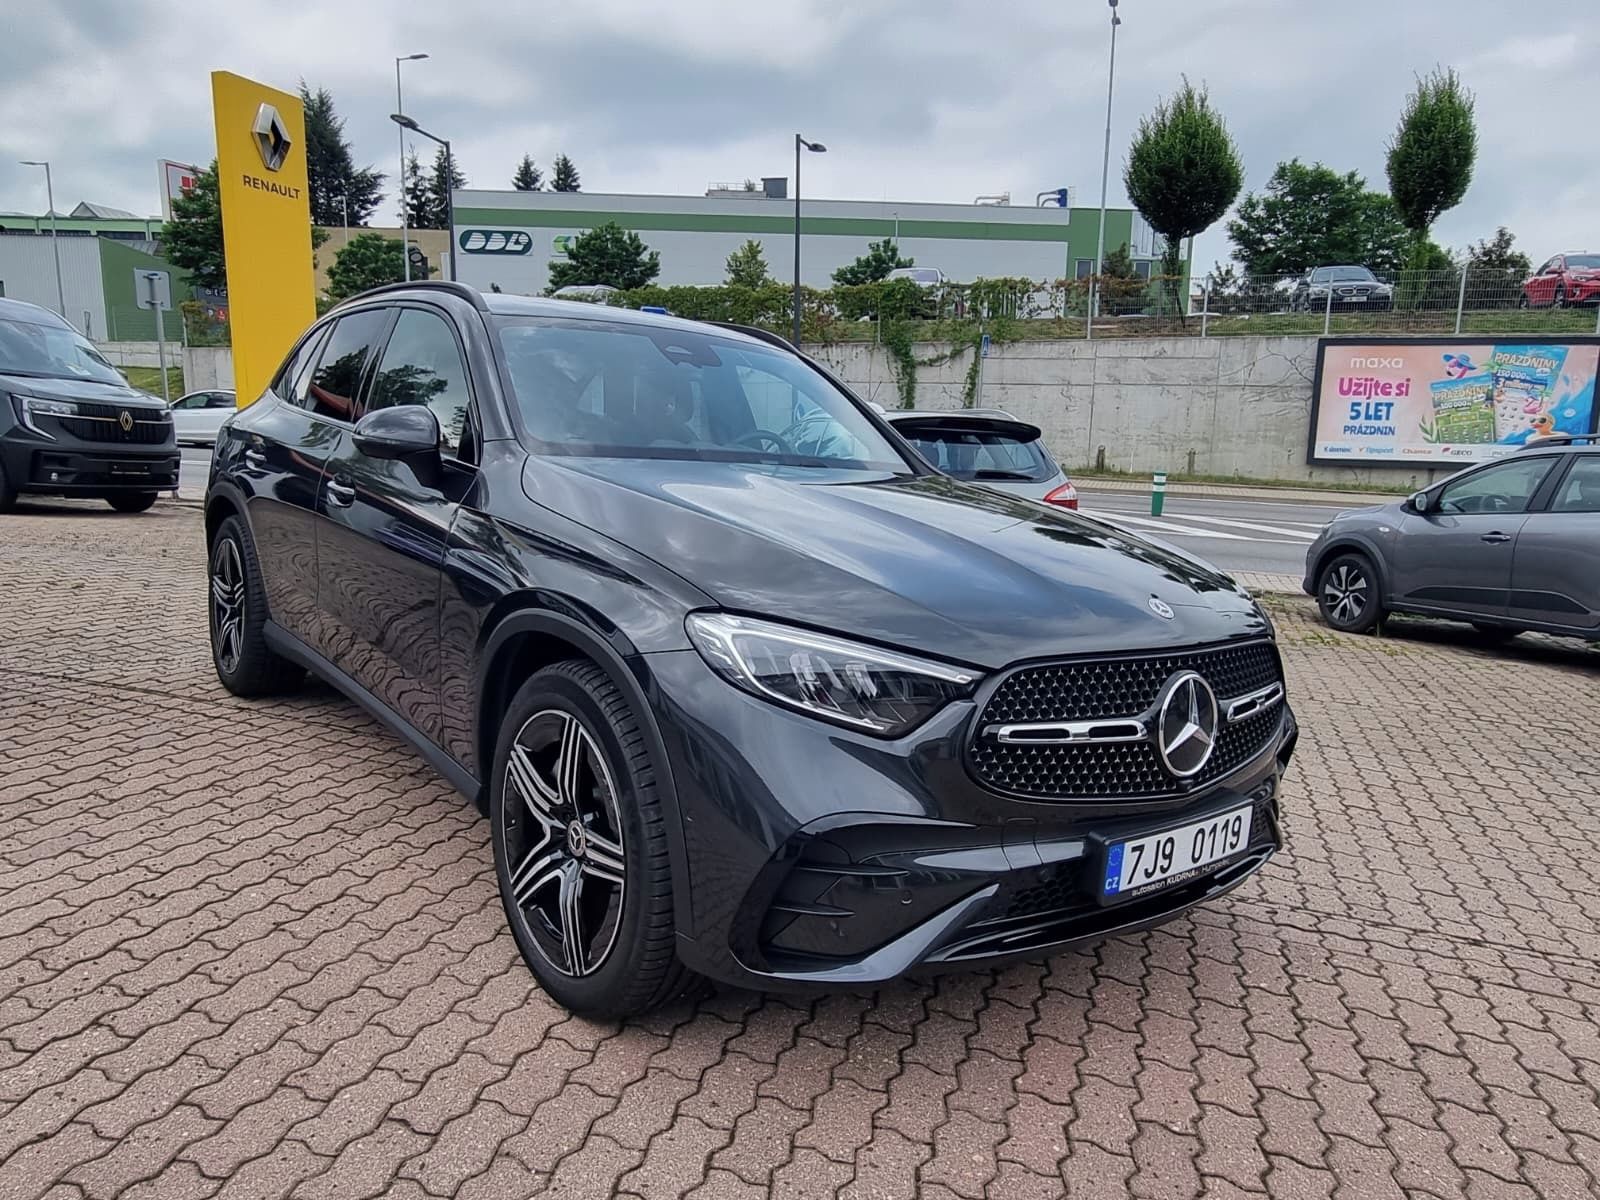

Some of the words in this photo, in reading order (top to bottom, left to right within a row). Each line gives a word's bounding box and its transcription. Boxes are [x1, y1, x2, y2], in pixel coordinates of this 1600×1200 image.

[243, 174, 301, 200] RENAULT
[1350, 357, 1404, 369] maxa
[1338, 376, 1393, 400] Užijte
[1395, 377, 1411, 397] si
[1349, 402, 1362, 421] 5
[1364, 402, 1394, 421] LET
[1343, 424, 1396, 436] PRÁZDNIN
[1127, 837, 1176, 885] 7J9
[1191, 815, 1242, 864] 0119
[1105, 876, 1119, 890] CZ
[1166, 869, 1197, 887] KUDRNA
